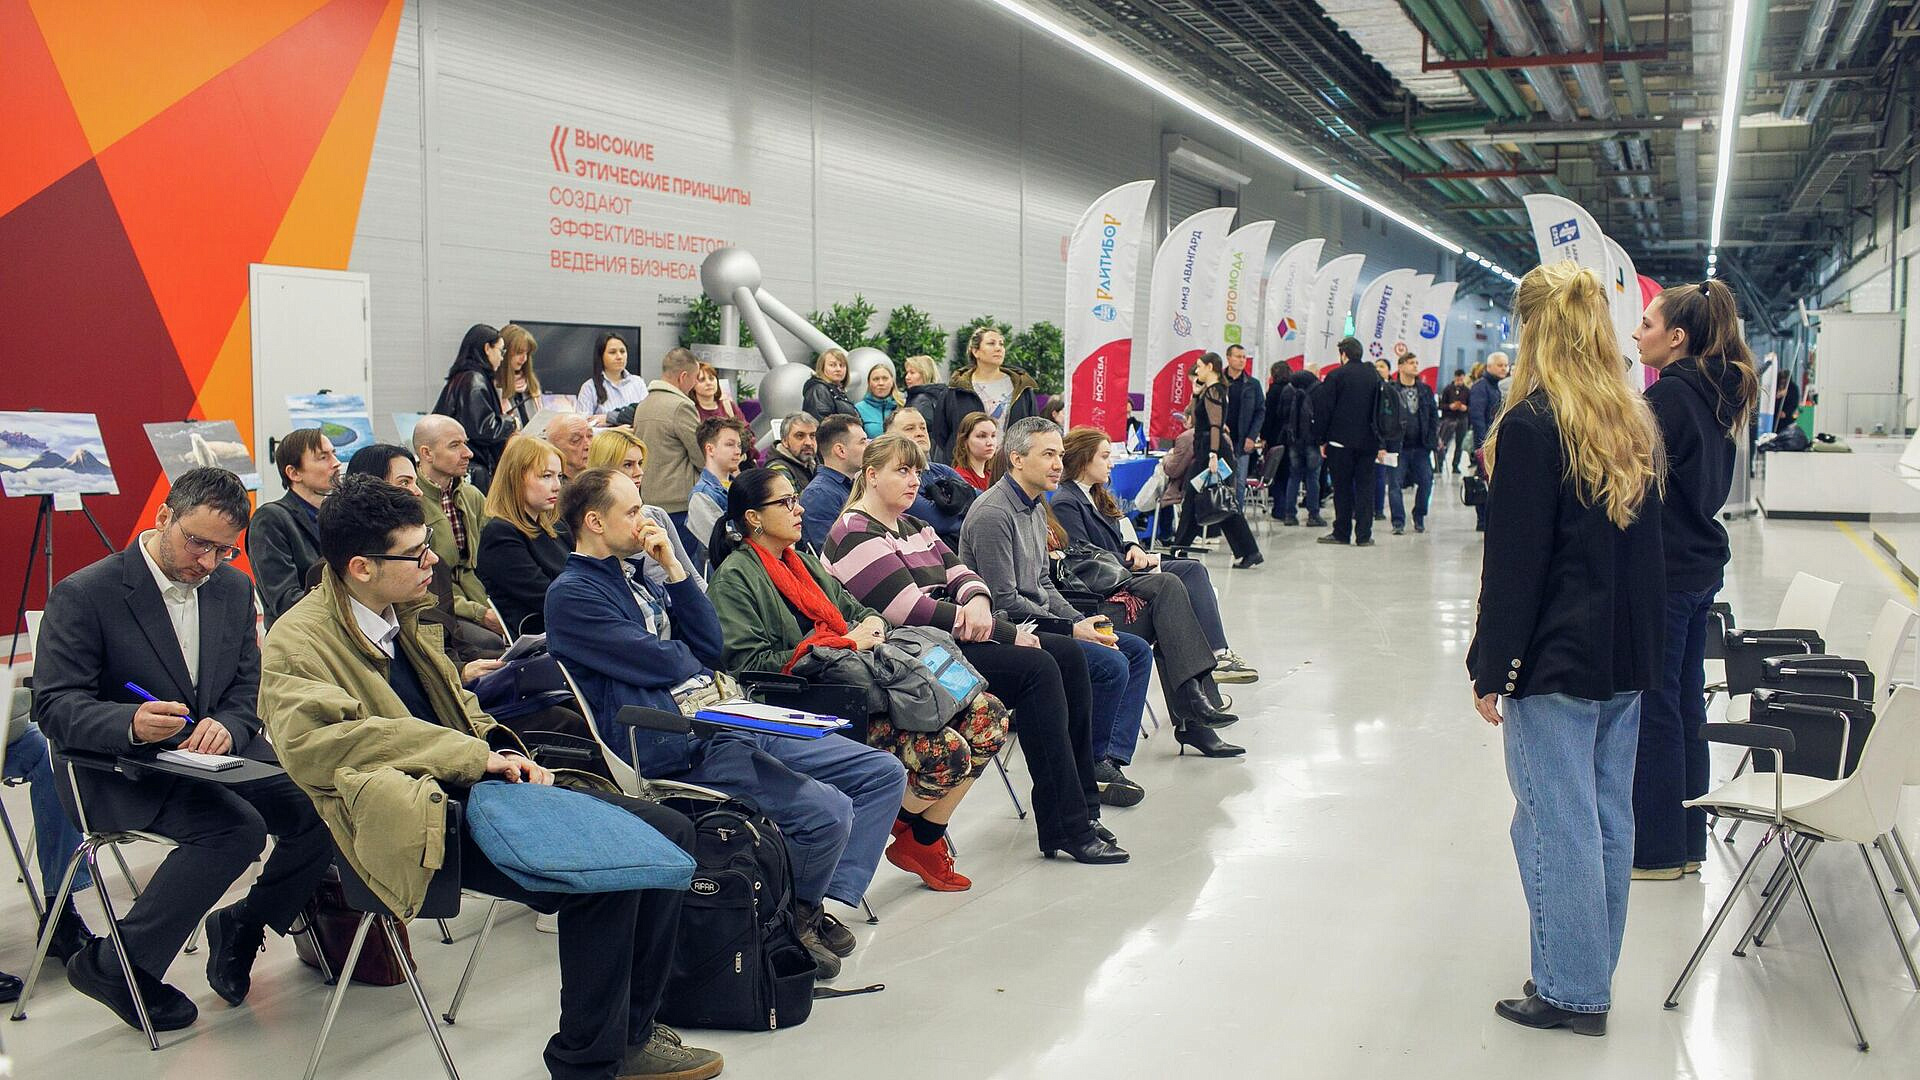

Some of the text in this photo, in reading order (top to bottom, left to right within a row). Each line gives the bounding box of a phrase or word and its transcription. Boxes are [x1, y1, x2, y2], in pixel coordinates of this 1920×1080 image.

[575, 128, 655, 161] ВЫСОКИЕ
[549, 185, 632, 215] СОЗДАЮТ
[575, 159, 751, 206] ЭТИЧЕСКИЕ ПРИНЦИПЫ
[550, 216, 675, 250] ЭФФЕКТИВНЫЕ
[551, 249, 698, 281] ВЕДЕНИЯ БИЗНЕСА
[1181, 230, 1203, 311] ММЗ АВАНГАРД
[1226, 251, 1244, 322] ОРТОМОДА
[1095, 355, 1105, 402] МОСКВА
[1173, 362, 1185, 404] МОСКВА
